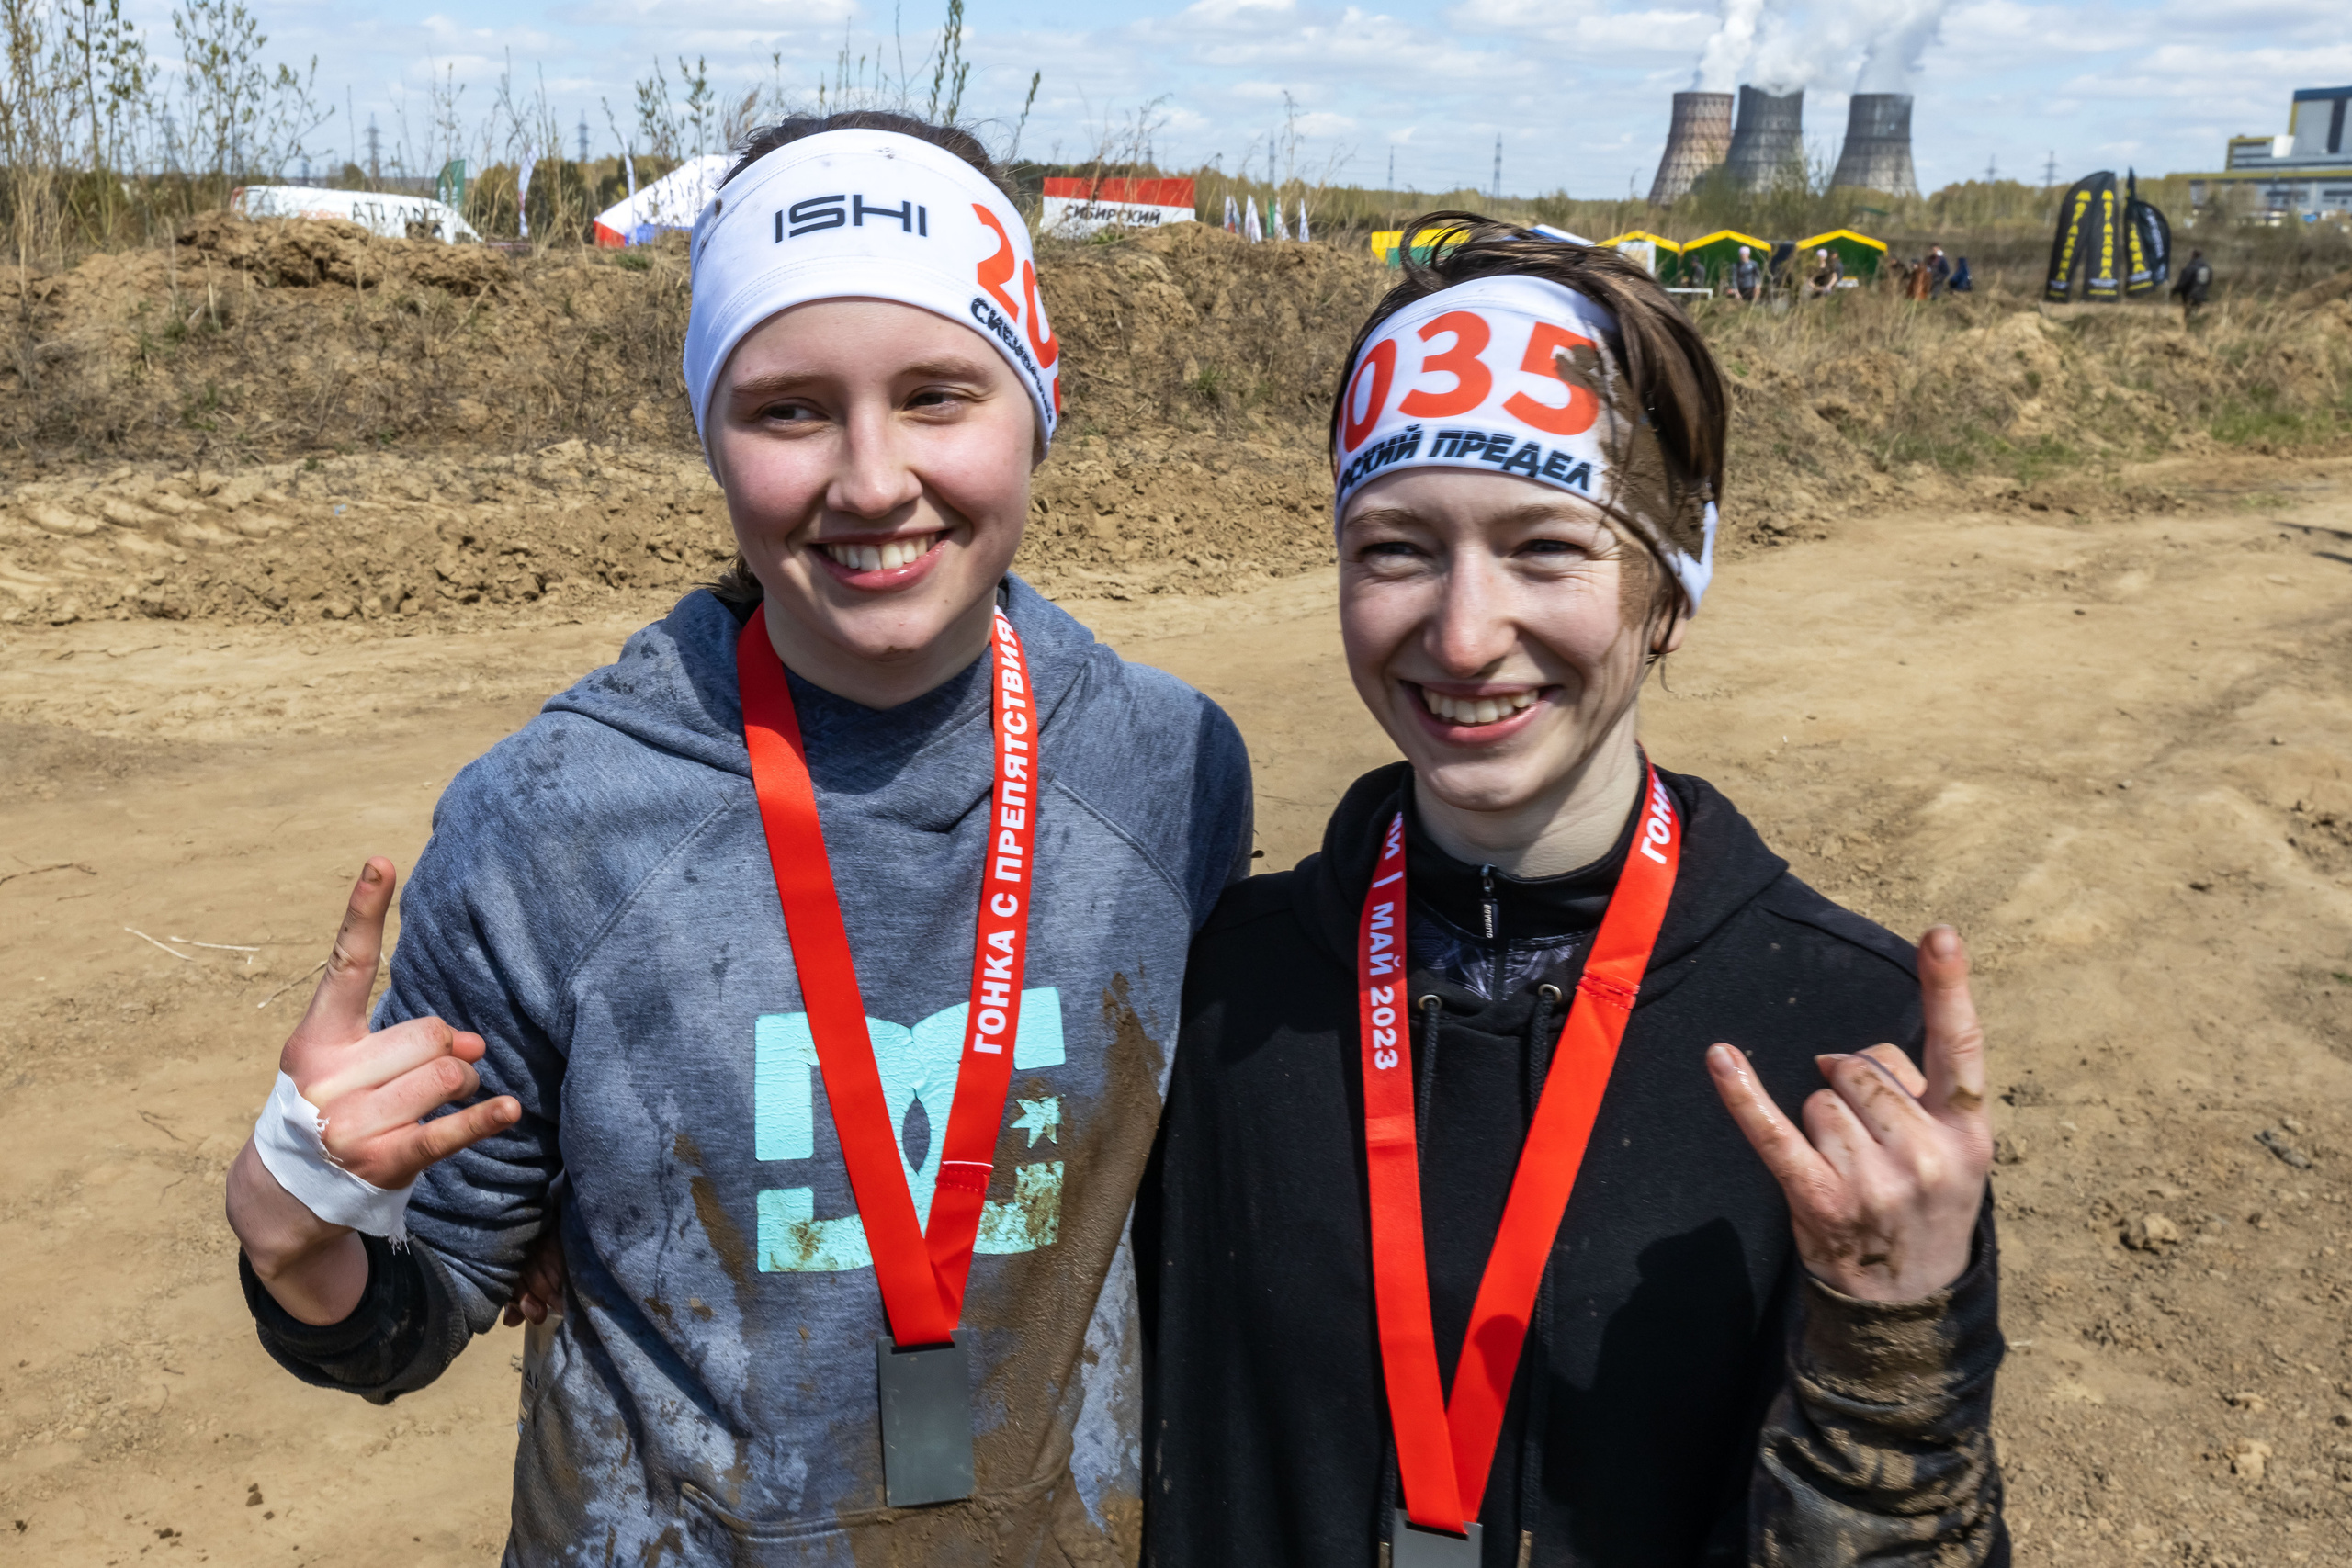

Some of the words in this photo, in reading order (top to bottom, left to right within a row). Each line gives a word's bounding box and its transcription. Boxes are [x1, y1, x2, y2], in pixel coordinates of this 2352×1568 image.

[775, 194, 927, 243] ISHI
[970, 202, 1060, 416] 20
[1338, 310, 1599, 453] 035
[1428, 429, 1592, 491] ПРЕДЕЛ
[990, 892, 1019, 918] С
[1369, 901, 1401, 976] МАЙ
[973, 930, 1016, 1055] ГОНКА
[1370, 985, 1399, 1071] 2023
